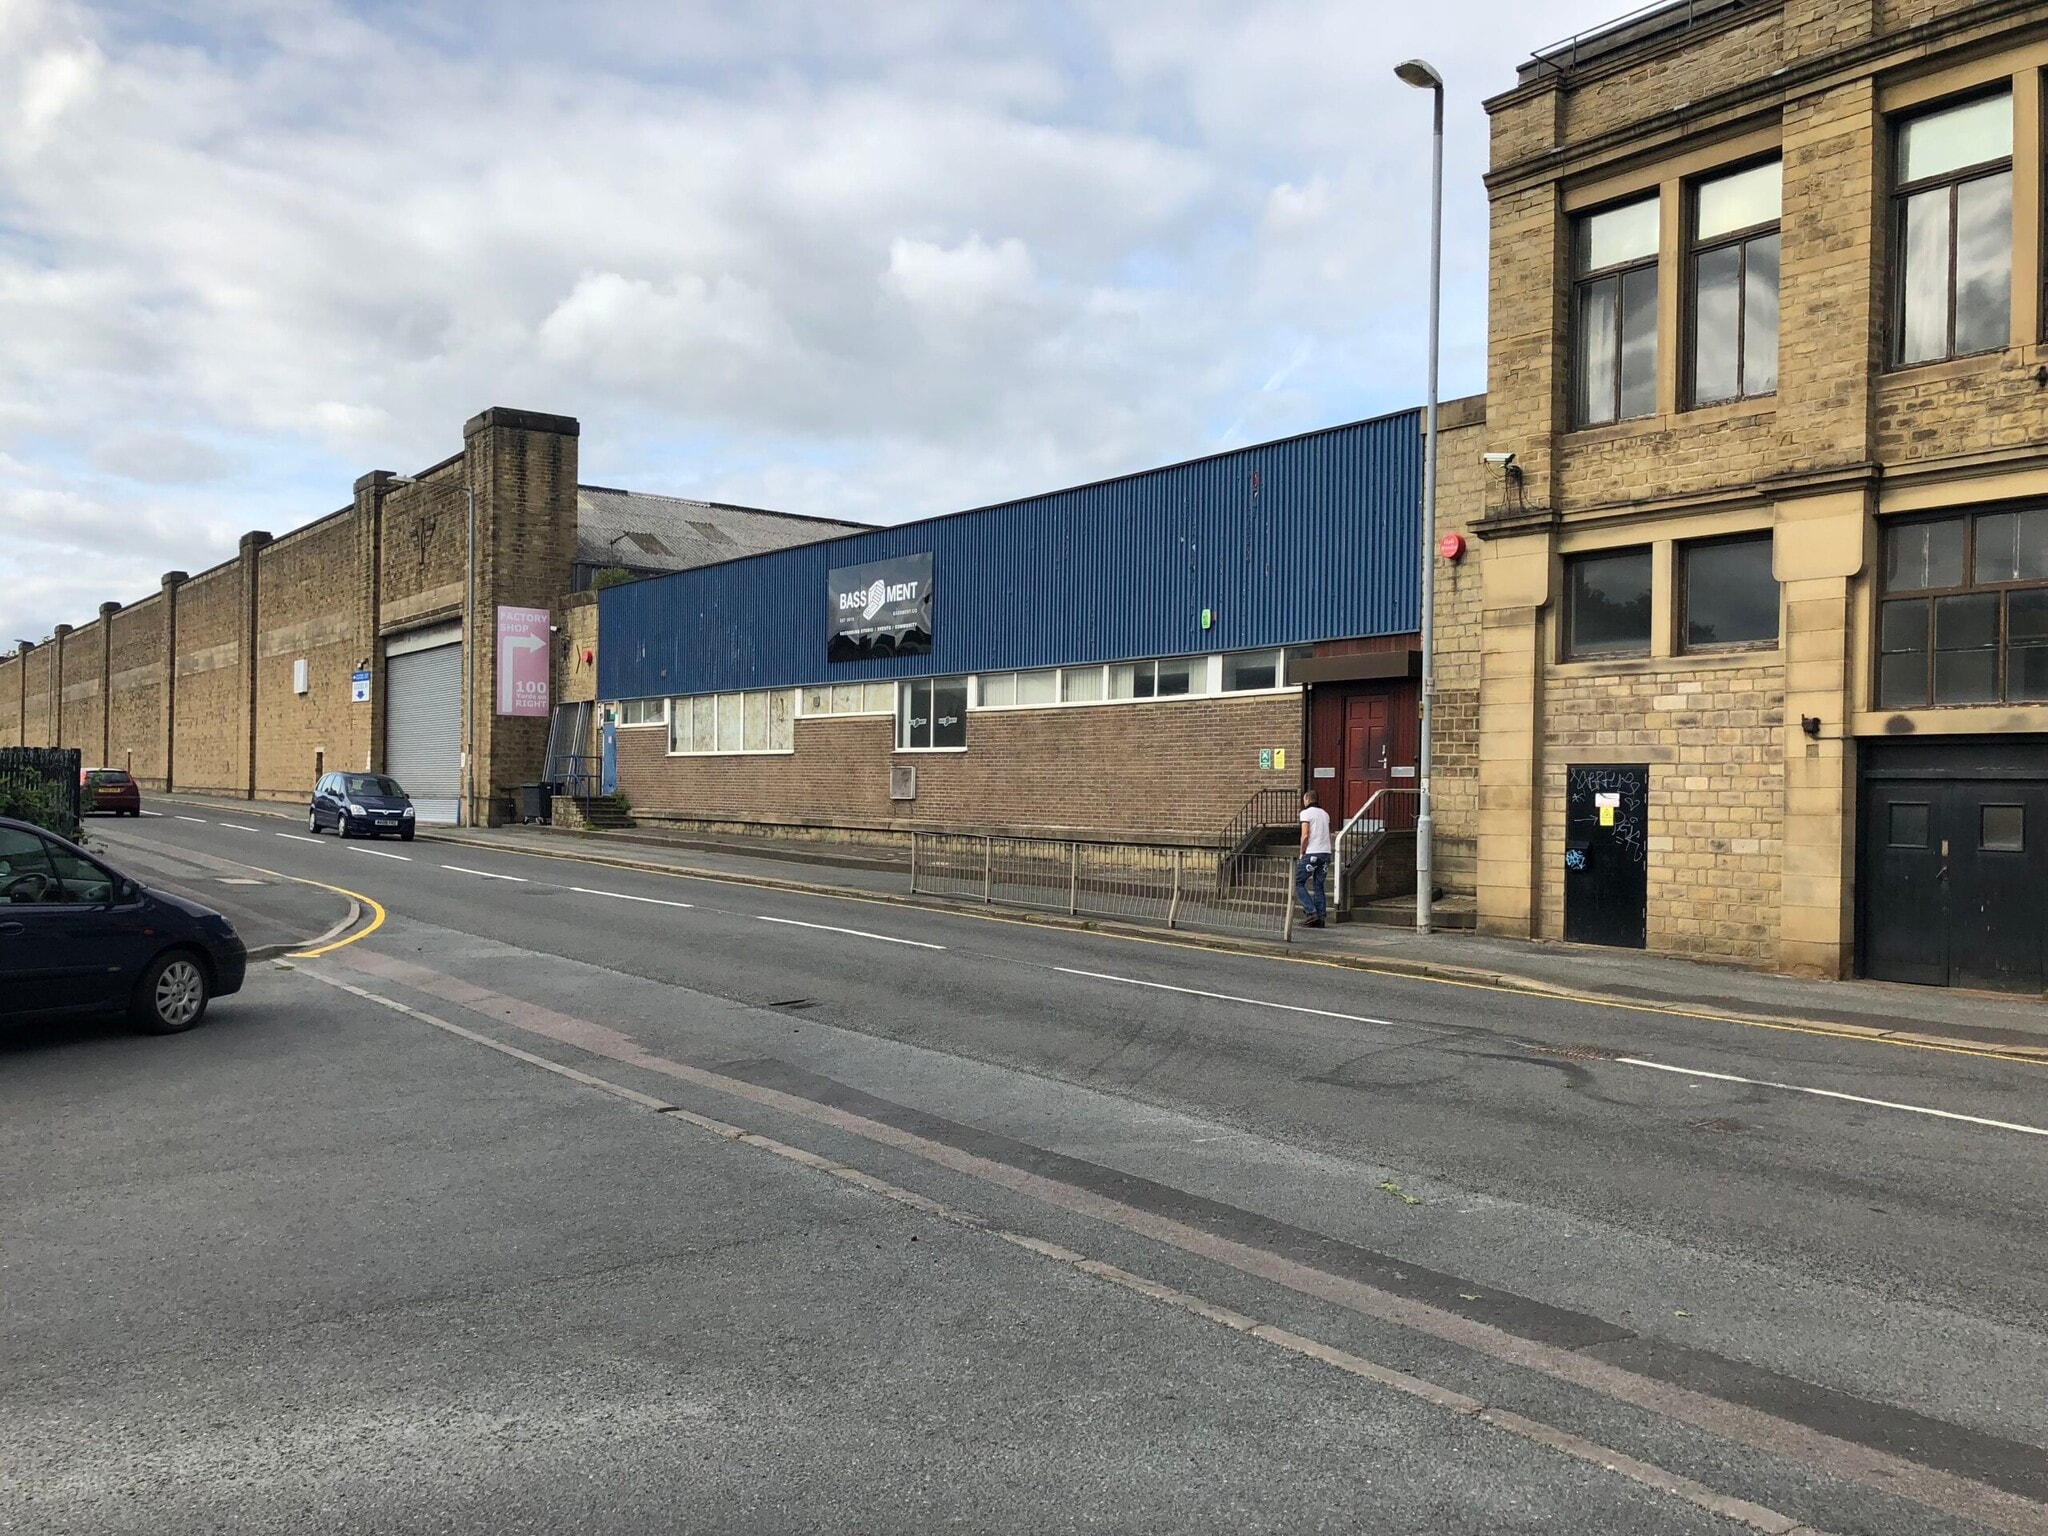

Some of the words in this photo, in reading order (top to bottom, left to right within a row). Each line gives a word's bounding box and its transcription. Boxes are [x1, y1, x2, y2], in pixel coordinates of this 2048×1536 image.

[840, 590, 867, 609] BASS
[886, 582, 918, 602] MENT
[500, 612, 547, 623] FACTORY
[500, 624, 529, 632] SHOP
[894, 622, 918, 630] COMMUNITY
[516, 681, 547, 693] 100
[515, 700, 547, 708] RIGHT
